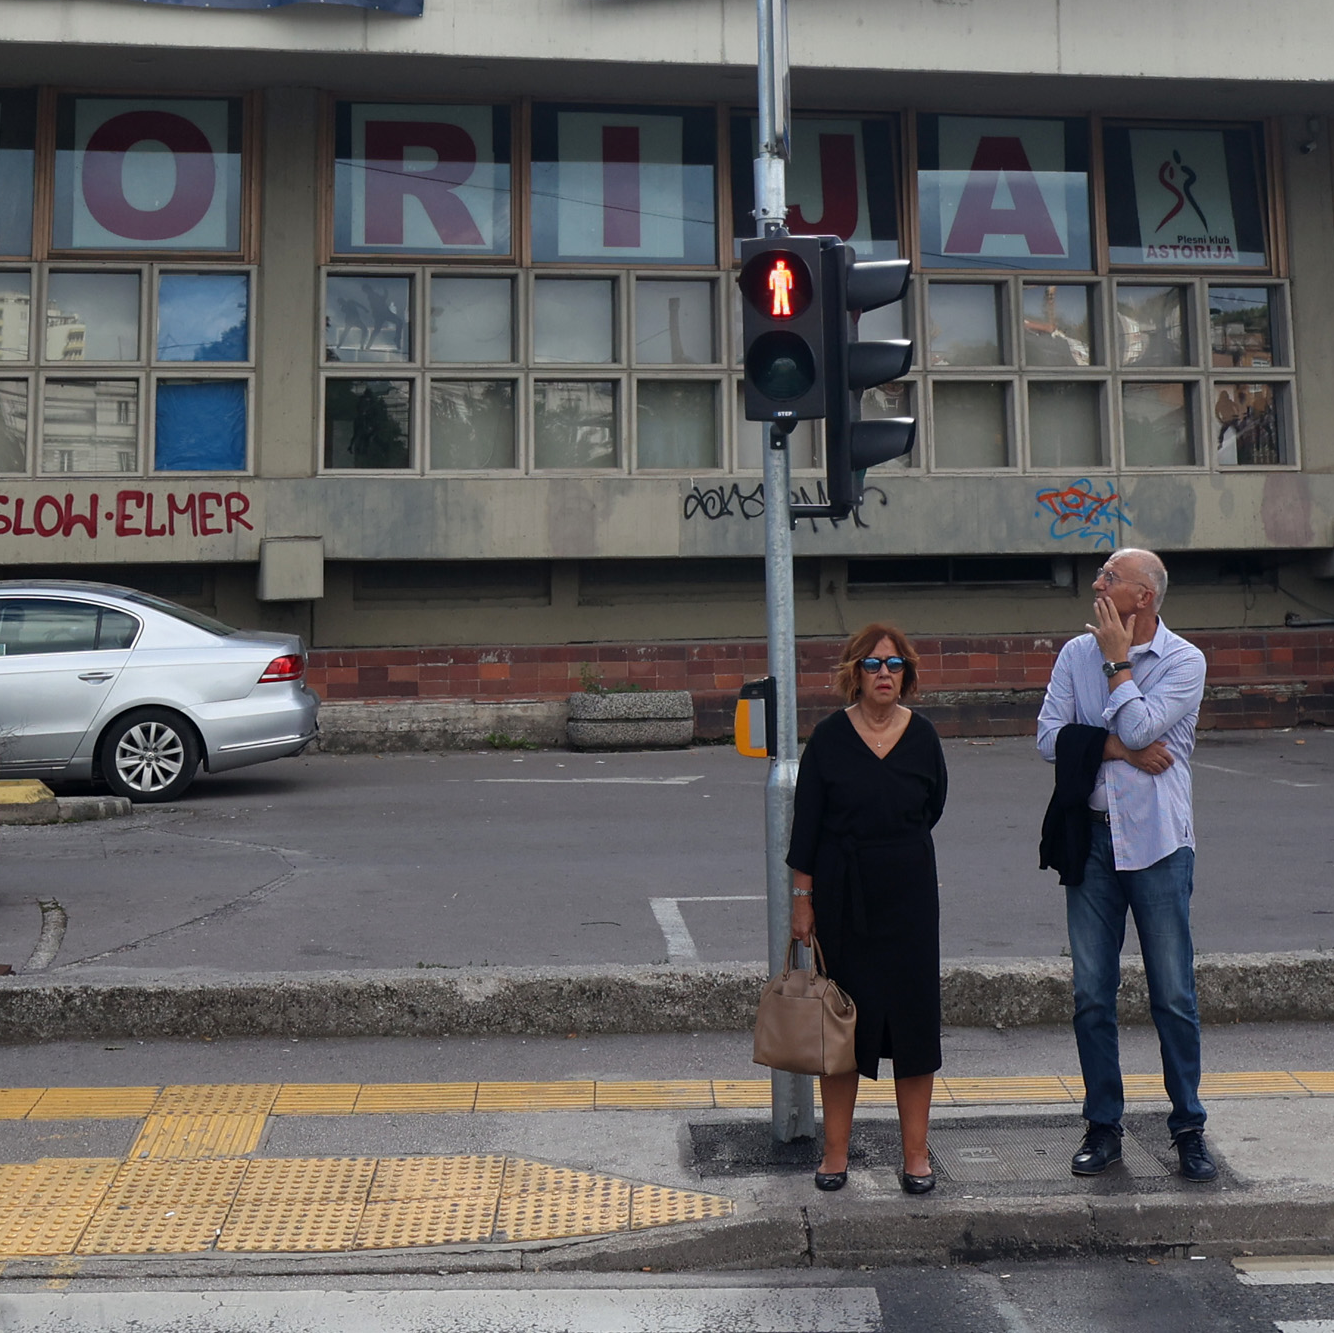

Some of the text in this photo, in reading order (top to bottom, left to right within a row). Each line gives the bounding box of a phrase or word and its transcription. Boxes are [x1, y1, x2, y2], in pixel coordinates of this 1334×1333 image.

[1177, 235, 1230, 244] Plesni klub
[1146, 244, 1235, 259] ASTORIJA
